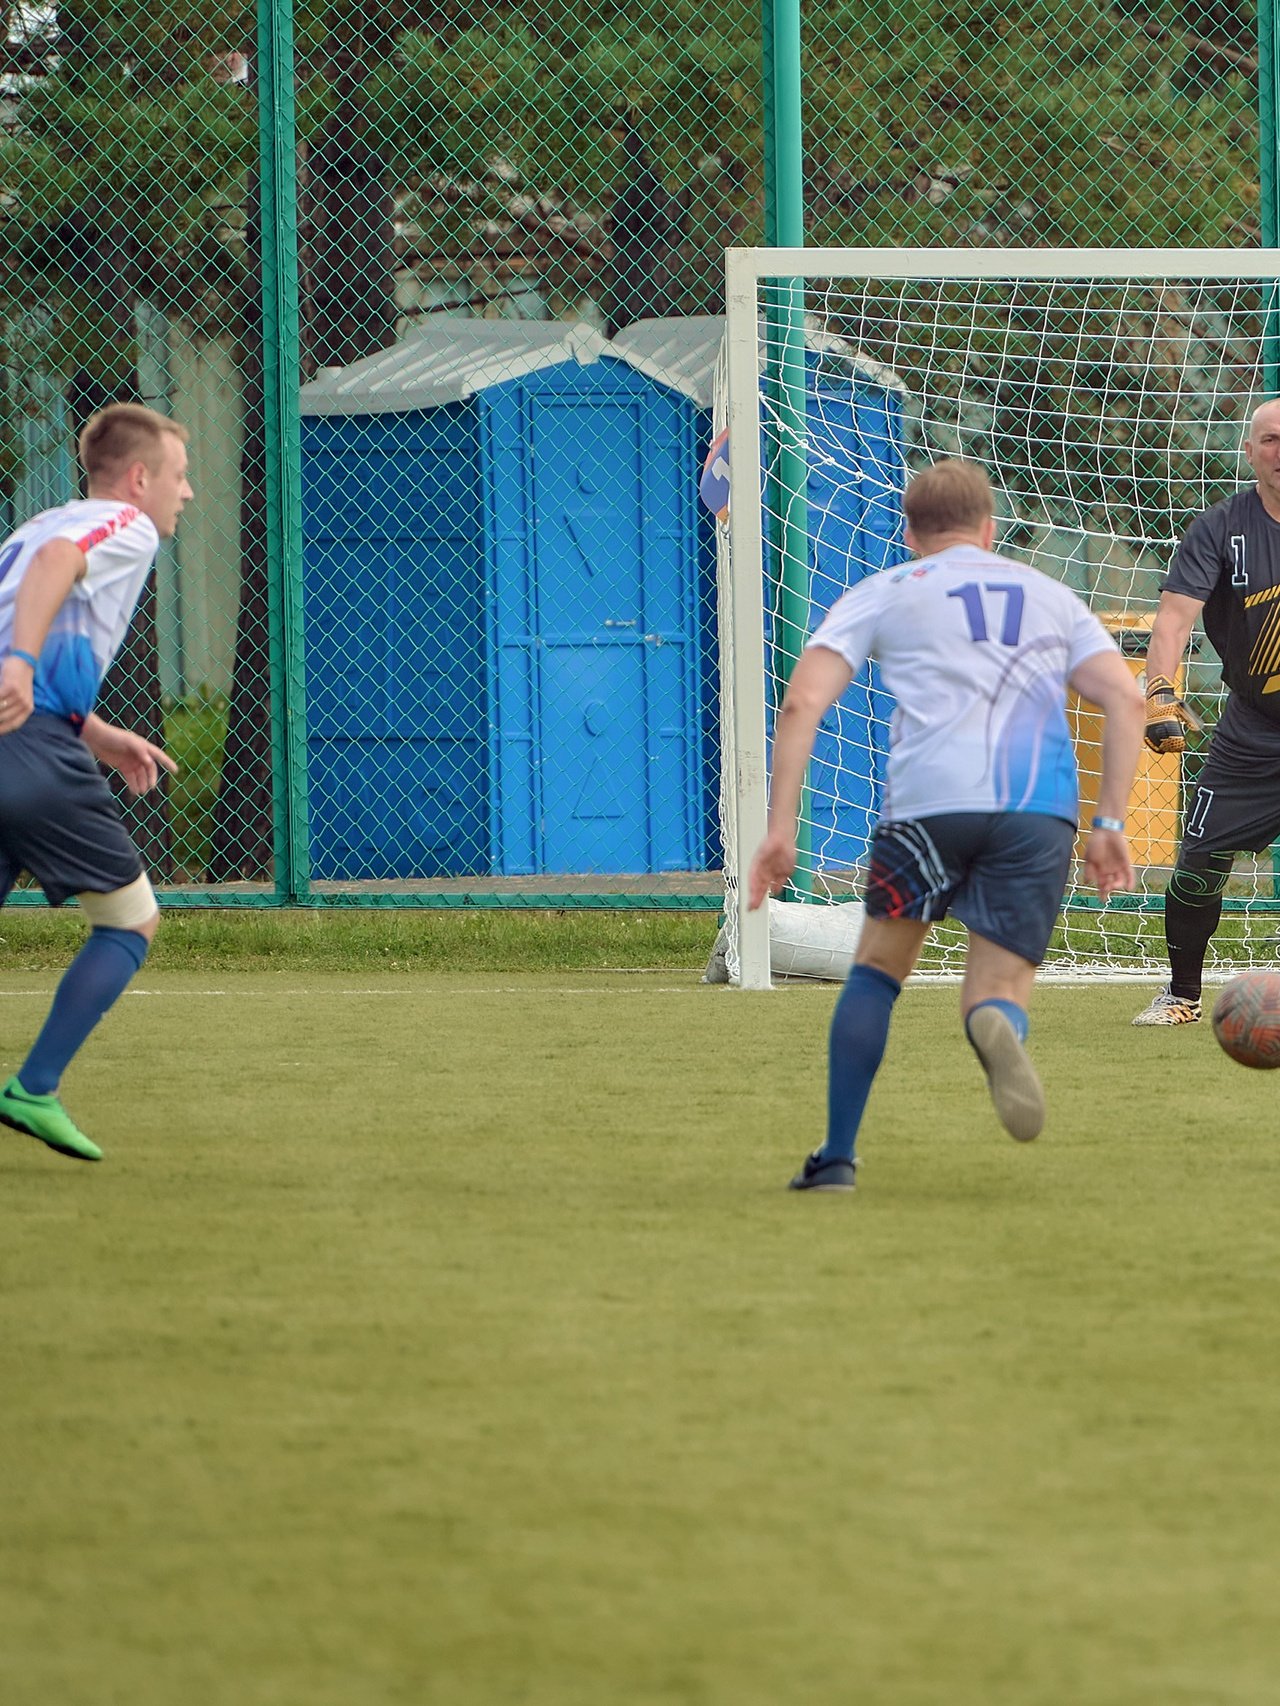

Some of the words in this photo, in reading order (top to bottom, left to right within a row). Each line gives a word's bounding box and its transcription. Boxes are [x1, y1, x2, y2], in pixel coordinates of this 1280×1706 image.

[1230, 534, 1249, 586] 1
[946, 581, 1025, 646] 17
[1187, 786, 1214, 838] 1
